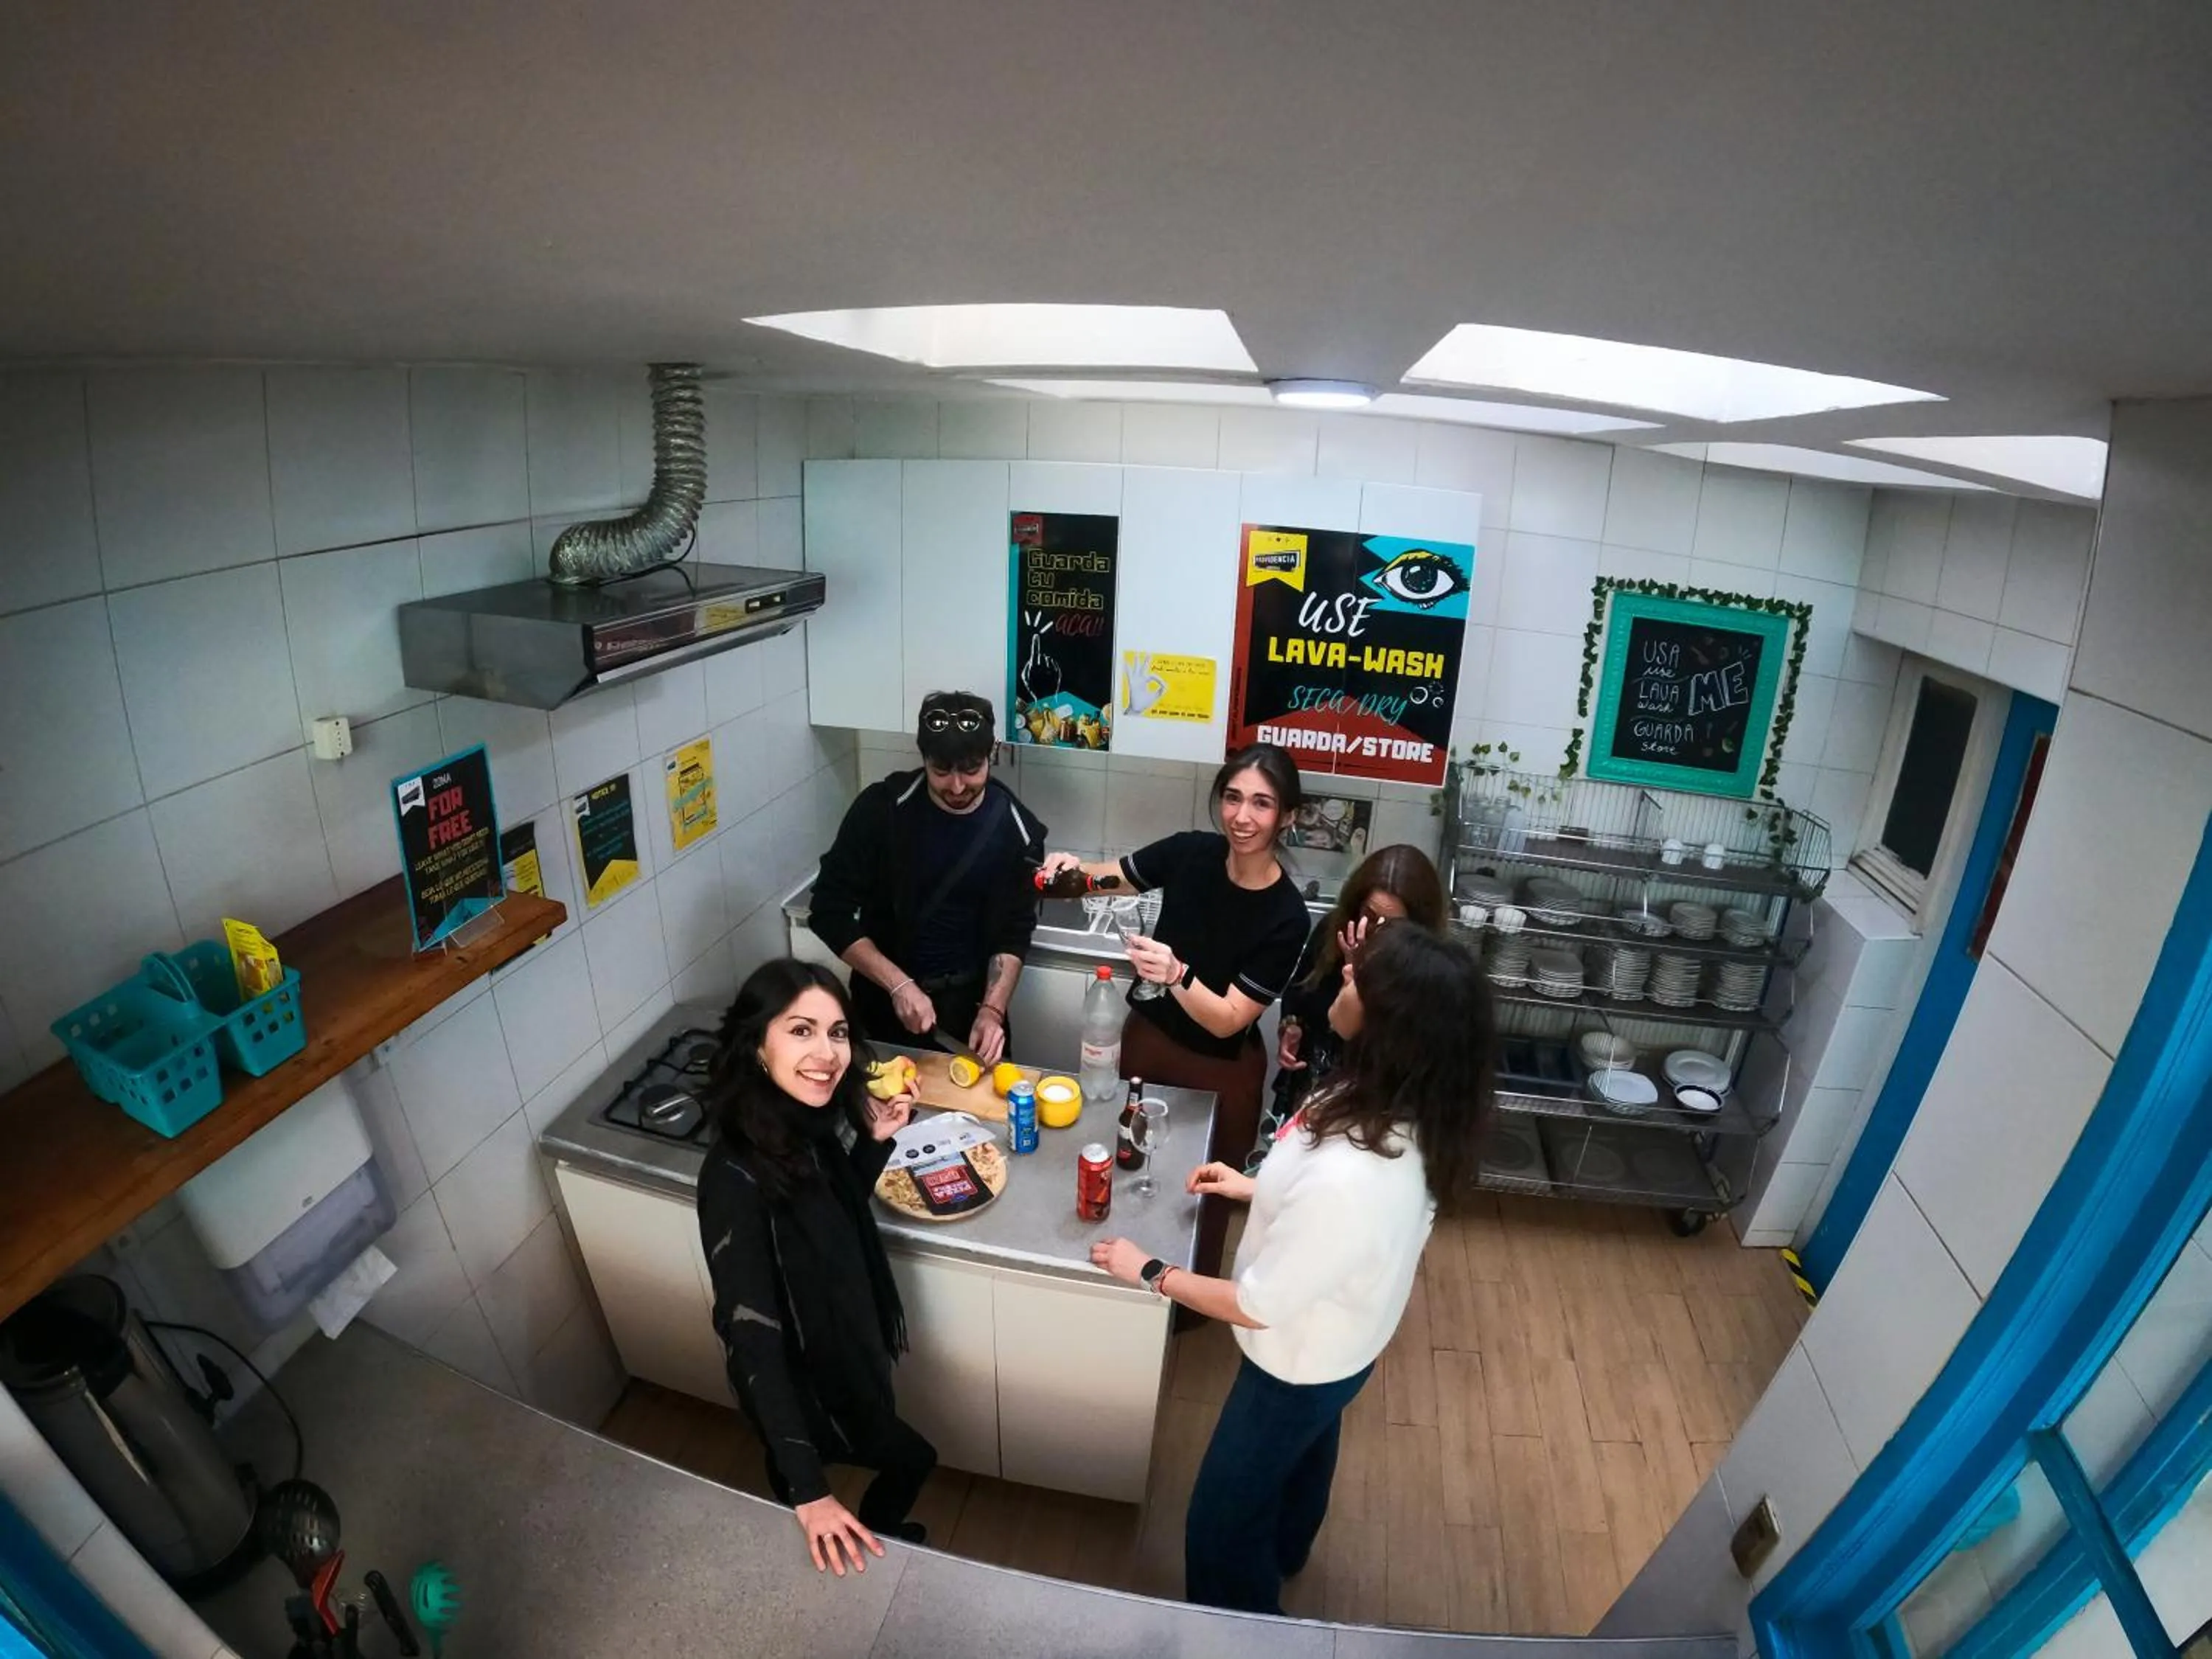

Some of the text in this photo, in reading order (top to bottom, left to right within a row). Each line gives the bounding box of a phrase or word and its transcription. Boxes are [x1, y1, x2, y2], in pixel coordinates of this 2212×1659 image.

[1027, 548, 1110, 573] Guarda
[1026, 588, 1105, 610] comida
[1298, 591, 1384, 637] USE
[1267, 636, 1445, 679] LAVA-WASH
[1643, 640, 1680, 669] USA
[1642, 666, 1676, 678] use
[1639, 681, 1680, 703] LAVA
[1688, 661, 1750, 716] ME
[1637, 700, 1674, 713] wash
[1256, 725, 1435, 763] GUARDA/STORE
[1633, 720, 1694, 742] GUARDA
[1641, 741, 1680, 756] store
[428, 785, 463, 821] FOR
[428, 810, 473, 850] FREE
